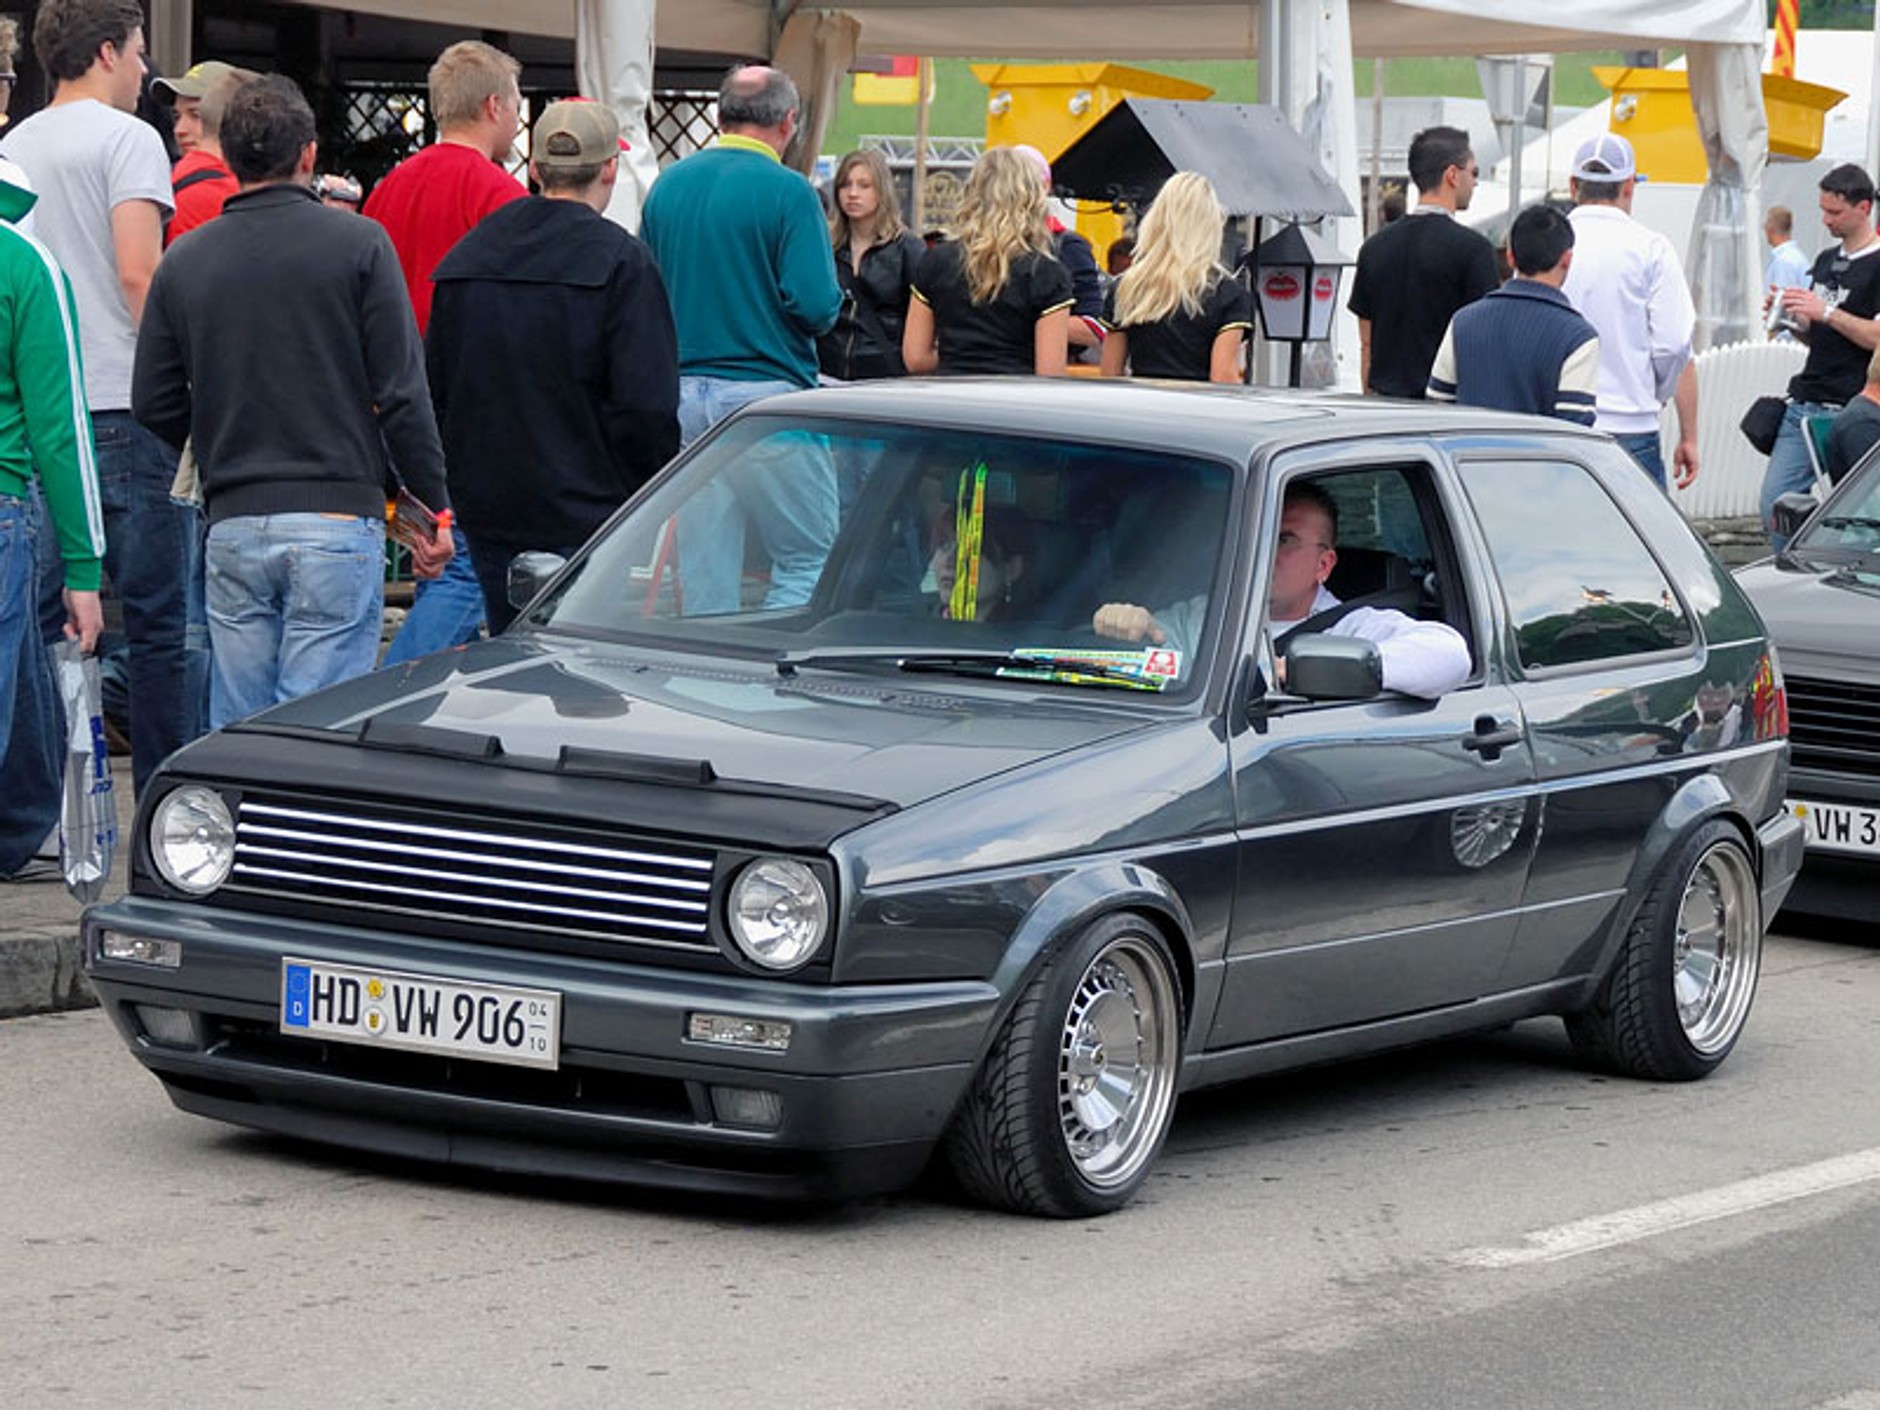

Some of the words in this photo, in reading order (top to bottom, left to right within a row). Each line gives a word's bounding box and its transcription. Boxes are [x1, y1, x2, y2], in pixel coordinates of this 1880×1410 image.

[1814, 808, 1850, 842] VW
[1860, 812, 1880, 845] 3
[294, 1001, 302, 1016] D
[312, 974, 360, 1025] HD
[393, 985, 440, 1037] VW
[453, 993, 525, 1047] 906
[529, 1001, 547, 1017] 04
[531, 1036, 546, 1052] 10
